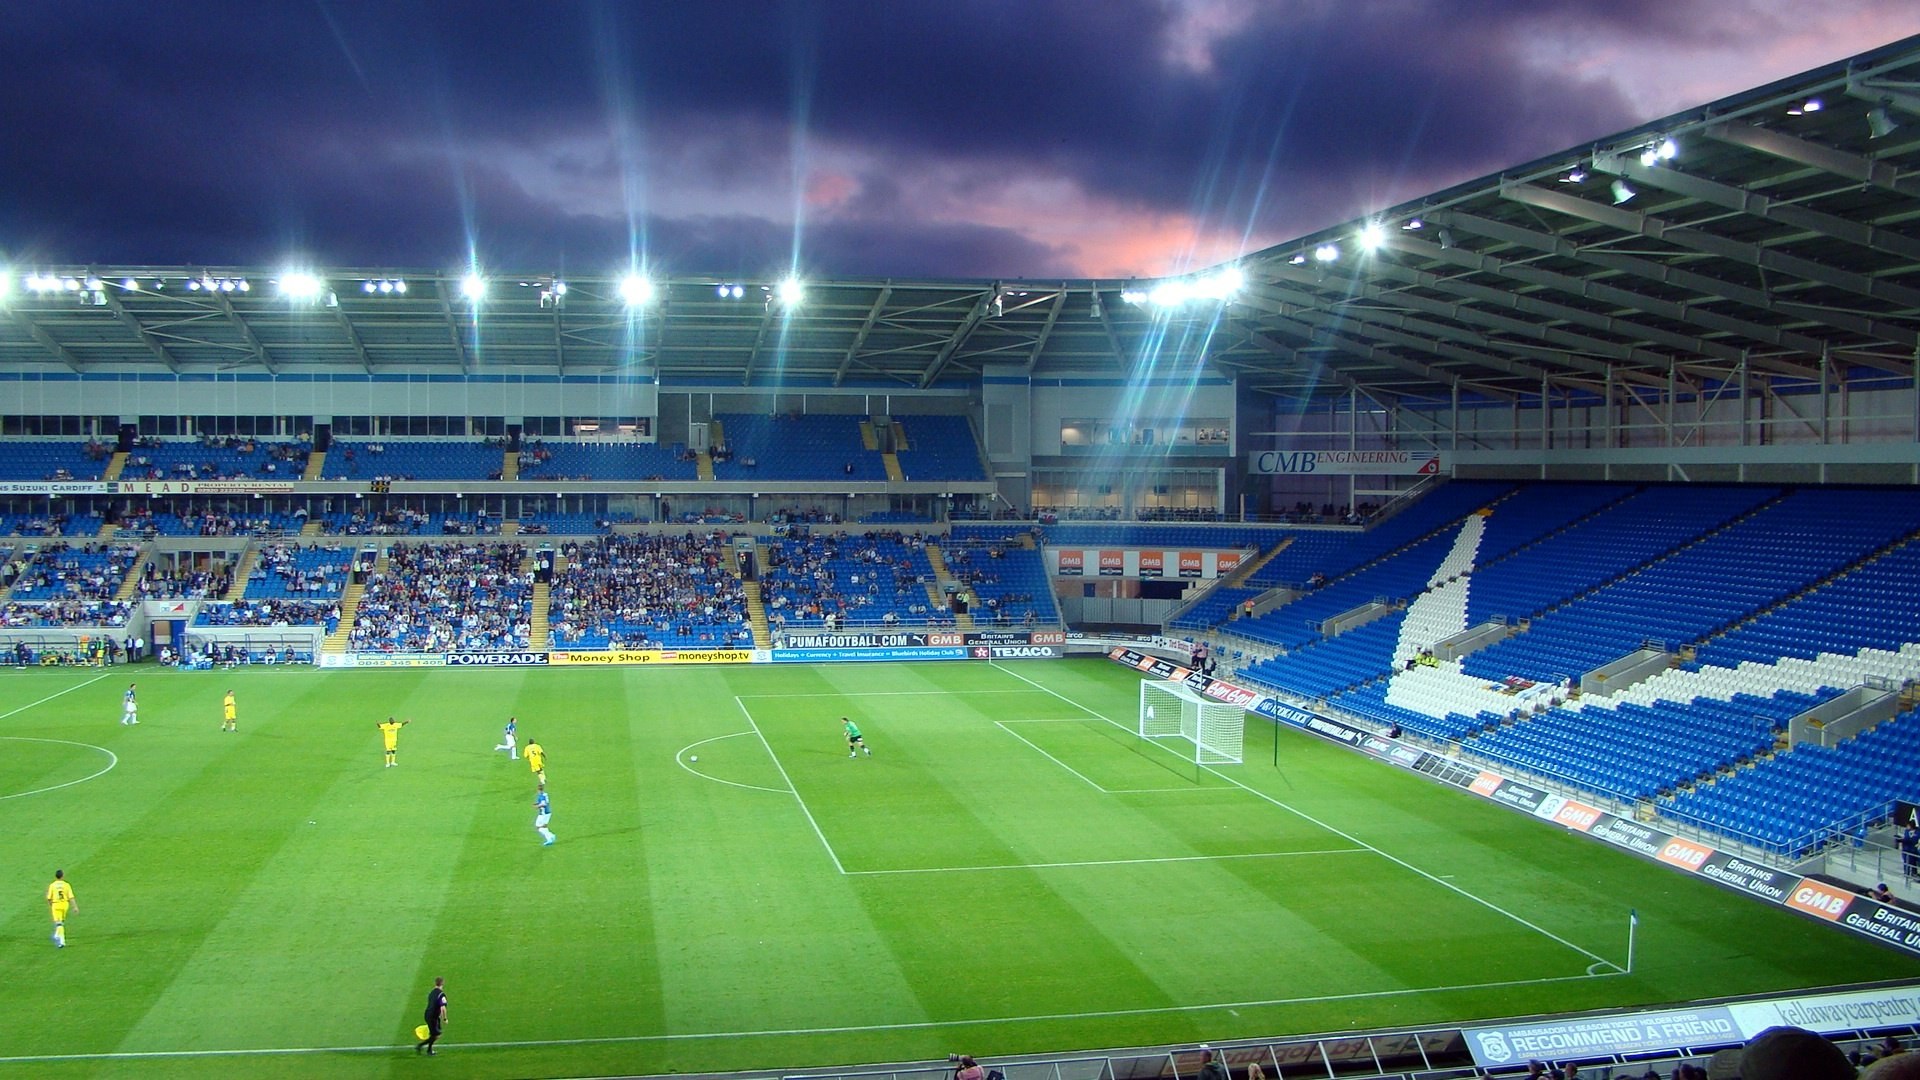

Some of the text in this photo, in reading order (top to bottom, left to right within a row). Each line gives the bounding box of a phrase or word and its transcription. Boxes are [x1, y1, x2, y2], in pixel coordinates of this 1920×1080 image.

[1257, 451, 1408, 473] CMB ENGINEERING
[12, 484, 48, 492] SUZUKI
[51, 484, 93, 492] CARDIFF
[1061, 557, 1081, 565] GMB
[1101, 557, 1121, 566] GMB
[1141, 558, 1161, 566] GMB
[1181, 559, 1201, 567] GMB
[789, 635, 907, 648] PUMAFOOTBALL.COM
[930, 635, 962, 645] GMB
[1033, 633, 1063, 643] GMB
[570, 654, 614, 663] Money
[618, 653, 650, 662] Shop
[678, 651, 749, 661] moneyshop.tv
[1476, 777, 1495, 791] GMB
[1559, 806, 1596, 827] GMB
[1592, 824, 1659, 853] GENERAL UNION
[1663, 842, 1706, 866] GMB
[1703, 864, 1783, 898] GENERAL UNION
[1794, 886, 1845, 915] GMB
[1846, 913, 1902, 941] GENERAL
[1773, 995, 1920, 1028] kellawaycarpentry
[1508, 1025, 1567, 1038] AMBASSADOR
[1575, 1022, 1610, 1032] SEASON
[1611, 1020, 1638, 1029] TICKET
[1640, 1017, 1673, 1026] HOLDER
[1673, 1014, 1699, 1022] OFFER
[1511, 1018, 1732, 1052] RECOMMEND A FRIEND
